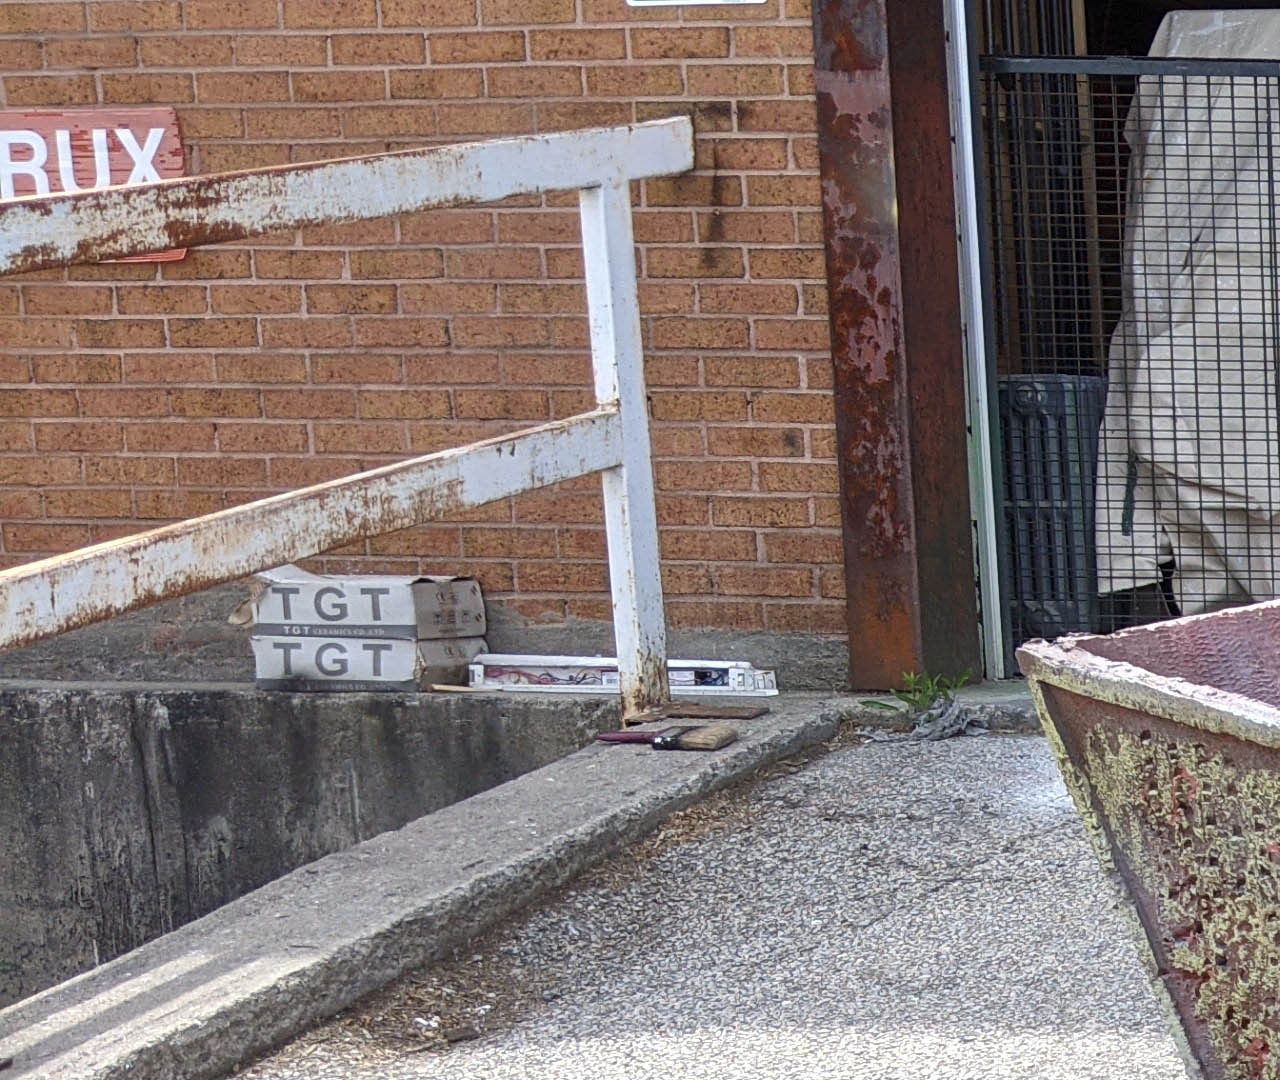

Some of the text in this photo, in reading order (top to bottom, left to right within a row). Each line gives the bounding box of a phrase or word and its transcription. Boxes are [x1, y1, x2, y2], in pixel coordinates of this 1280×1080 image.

[271, 586, 390, 622] TGT
[283, 626, 311, 636] TGT
[273, 642, 393, 677] TGT
